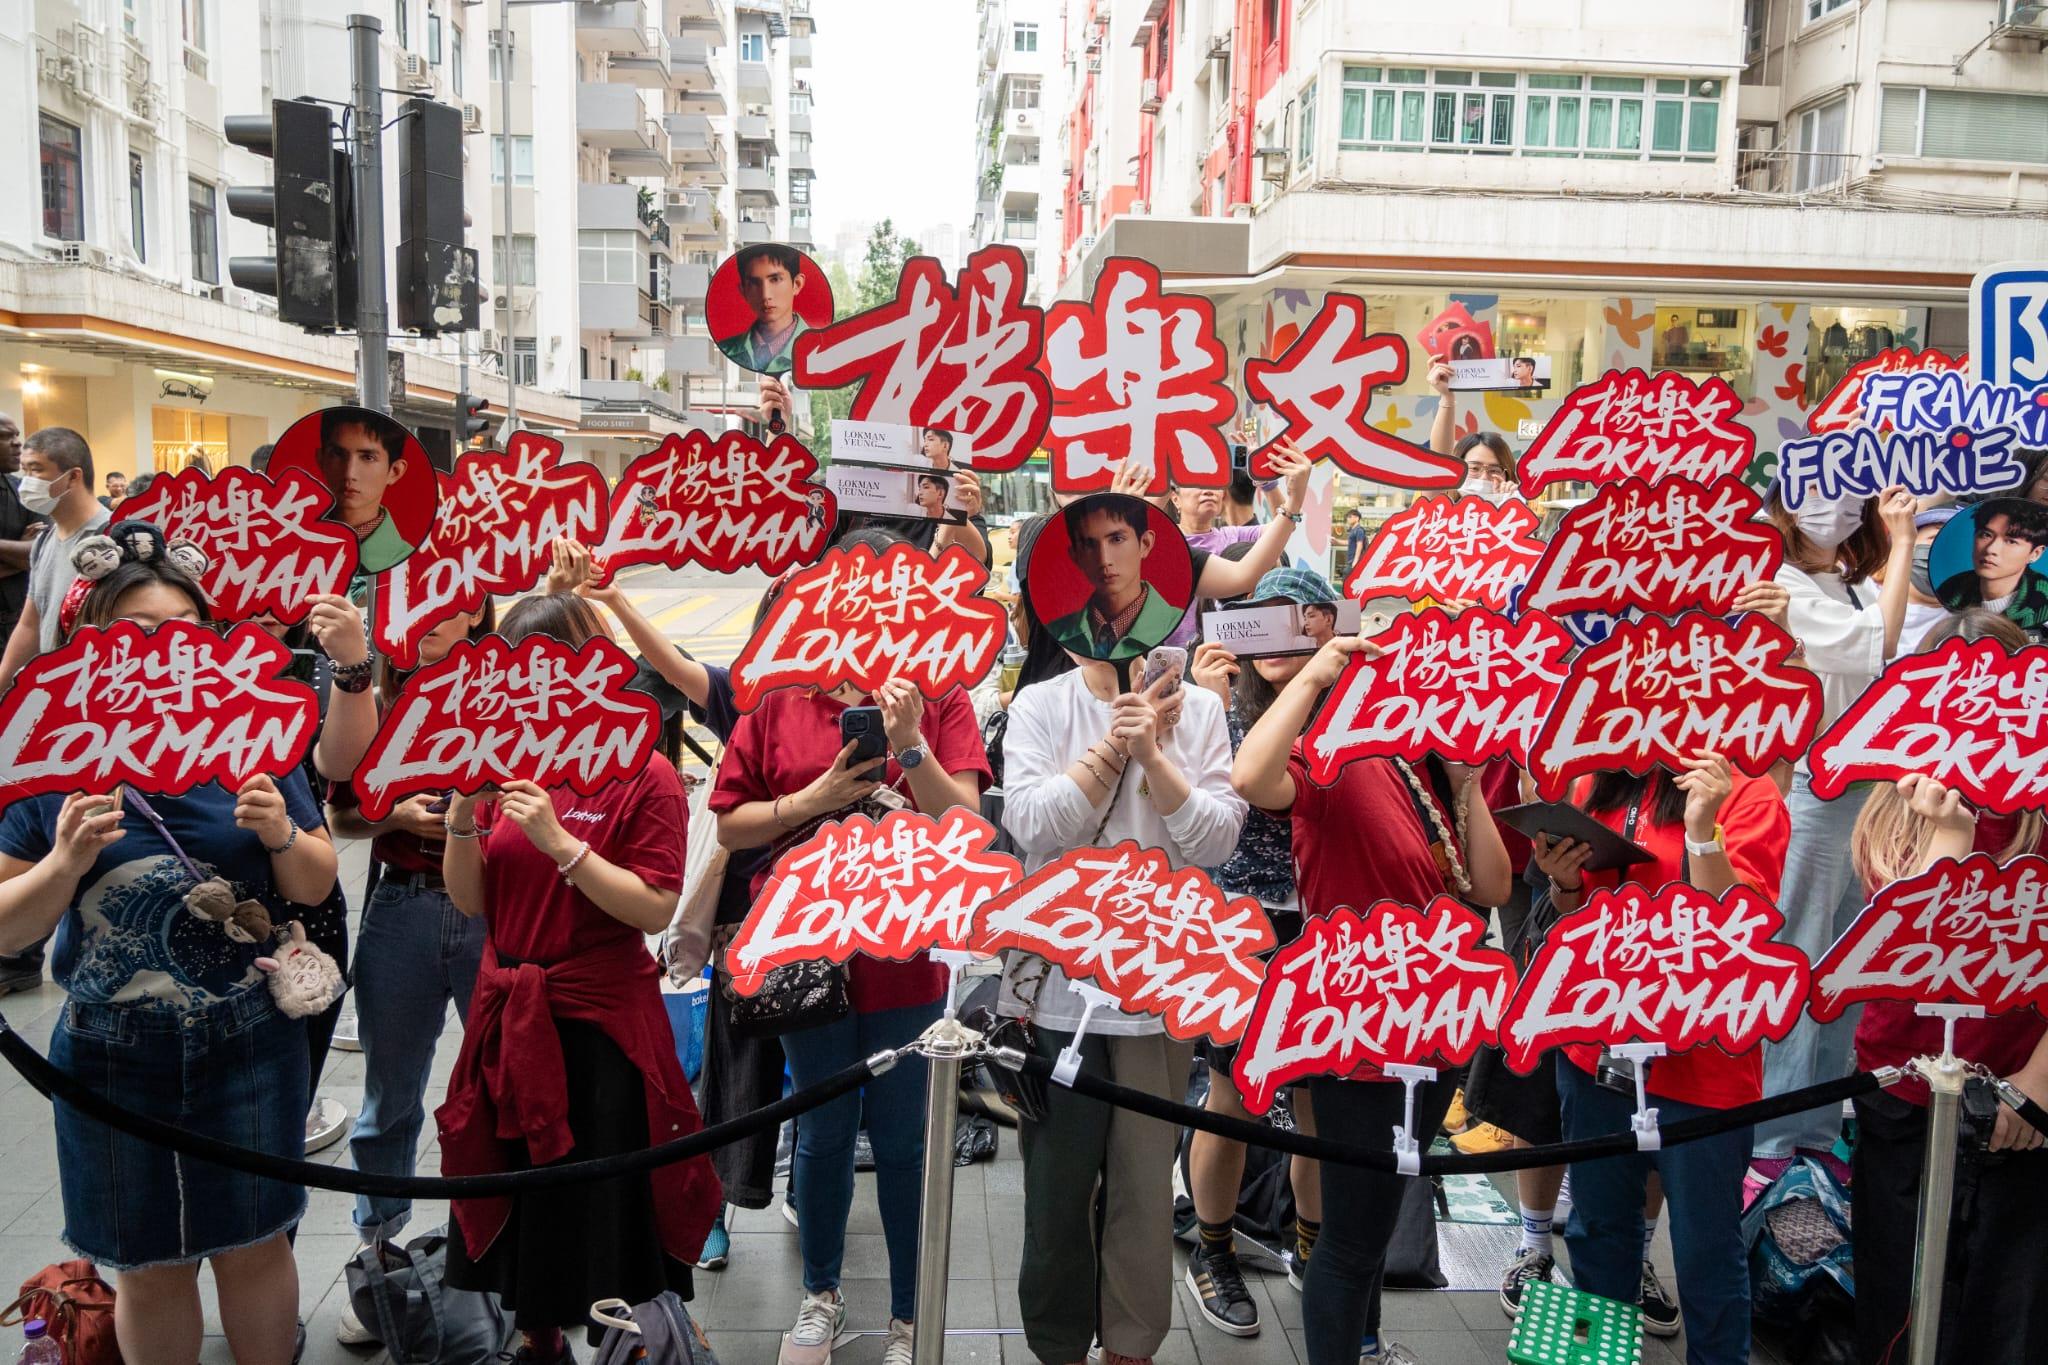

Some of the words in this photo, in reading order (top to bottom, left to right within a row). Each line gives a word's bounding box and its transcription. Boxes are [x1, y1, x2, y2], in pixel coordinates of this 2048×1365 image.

[843, 430, 886, 441] LOKMAN
[843, 438, 877, 448] YEUNG
[1526, 408, 1745, 490] LOKMAN
[1577, 378, 1747, 441] 楊樂文
[118, 477, 347, 551] 楊樂文
[637, 441, 813, 508] 楊樂文
[838, 480, 880, 490] LOKMAN
[838, 487, 872, 498] YEUNG
[593, 482, 821, 571] LOKMAN
[1392, 503, 1544, 555] 楊樂文
[1573, 485, 1772, 555] 楊樂文
[384, 480, 597, 660] LOKMAN
[796, 552, 996, 626] 楊樂文
[1528, 531, 1772, 611] LOKMAN
[740, 598, 995, 702] LOKMAN
[1216, 620, 1261, 632] LOKMAN
[1216, 631, 1252, 640] YEUNG
[1366, 616, 1564, 694] 楊樂文
[1587, 623, 1810, 704] 楊樂文
[36, 631, 308, 720] 楊樂文
[420, 645, 649, 726] 楊樂文
[0, 687, 307, 788] LOKMAN
[364, 696, 649, 811] LOKMAN
[1540, 676, 1810, 791] LOKMAN
[562, 807, 606, 823] LOKMAN
[789, 818, 1011, 898] 楊樂文
[980, 868, 1260, 1031] LOKMAN
[1075, 852, 1264, 984] 楊樂文
[1562, 894, 1799, 977] 楊樂文
[1282, 912, 1504, 1005] 楊樂文
[1243, 972, 1507, 1104] LOKMAN
[1510, 946, 1799, 1063] LOKMAN
